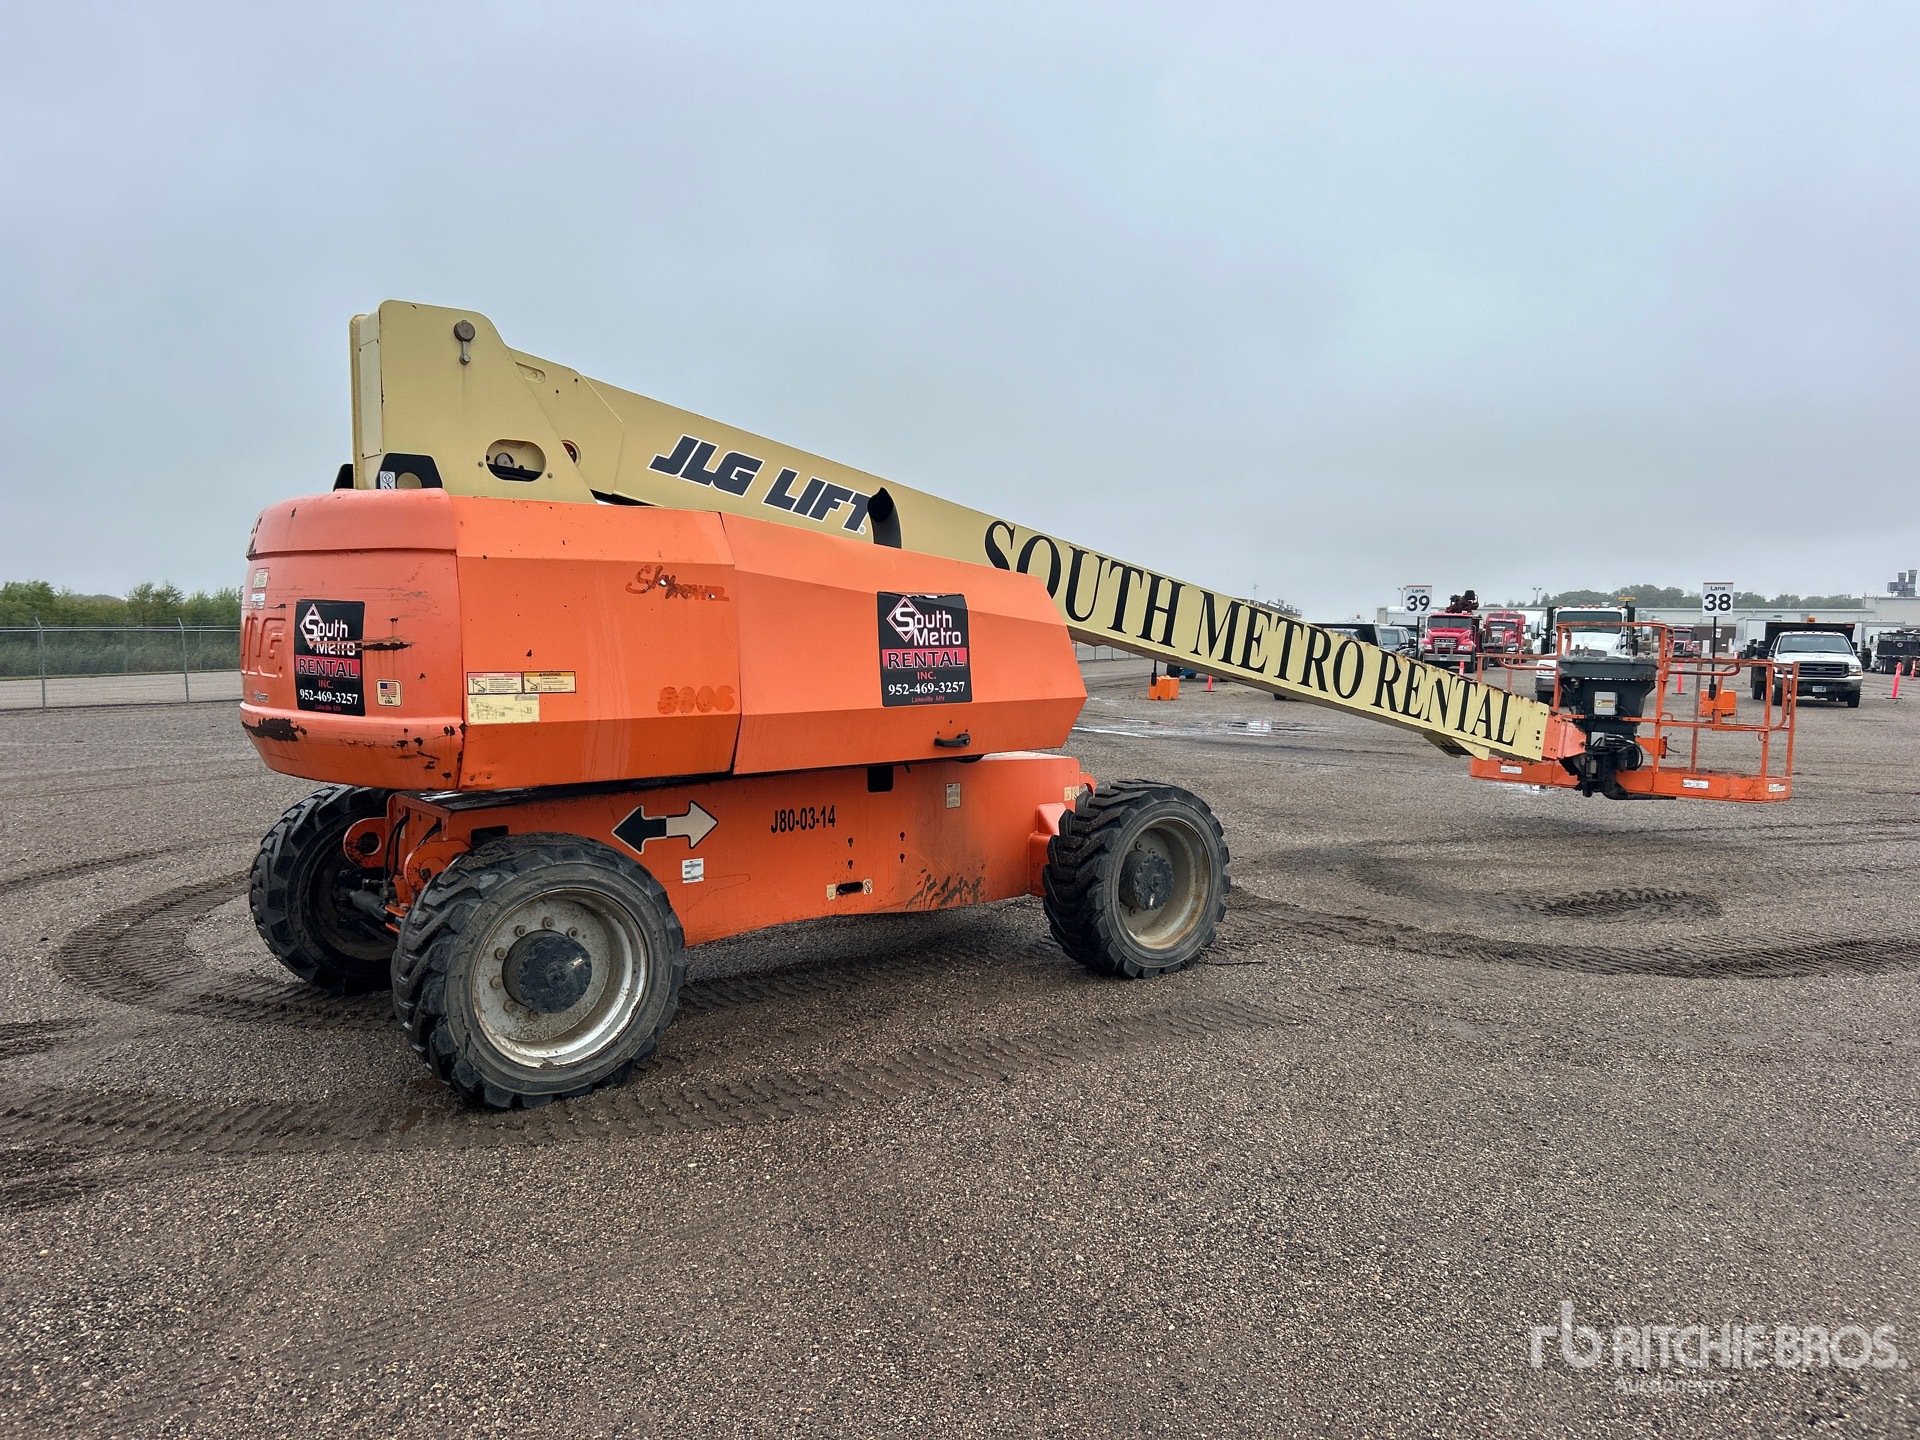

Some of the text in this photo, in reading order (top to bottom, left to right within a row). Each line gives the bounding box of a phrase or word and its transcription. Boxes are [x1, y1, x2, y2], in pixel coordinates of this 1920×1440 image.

[647, 434, 871, 532] JLG LIFT
[1407, 595, 1430, 612] 39
[1704, 593, 1731, 611] 38
[305, 615, 348, 638] South
[895, 607, 952, 631] South
[316, 637, 356, 656] Metro
[913, 628, 962, 646] Metro
[298, 658, 358, 679] RENTAL
[886, 650, 965, 669] RENTAL
[1190, 590, 1364, 699] METRO
[1371, 649, 1516, 746] RENTAL
[318, 680, 334, 689] INC.
[917, 671, 937, 680] INC.
[299, 688, 359, 705] 952-469-3257
[888, 681, 966, 695] 952-469-3257
[770, 804, 836, 834] J80-03-14
